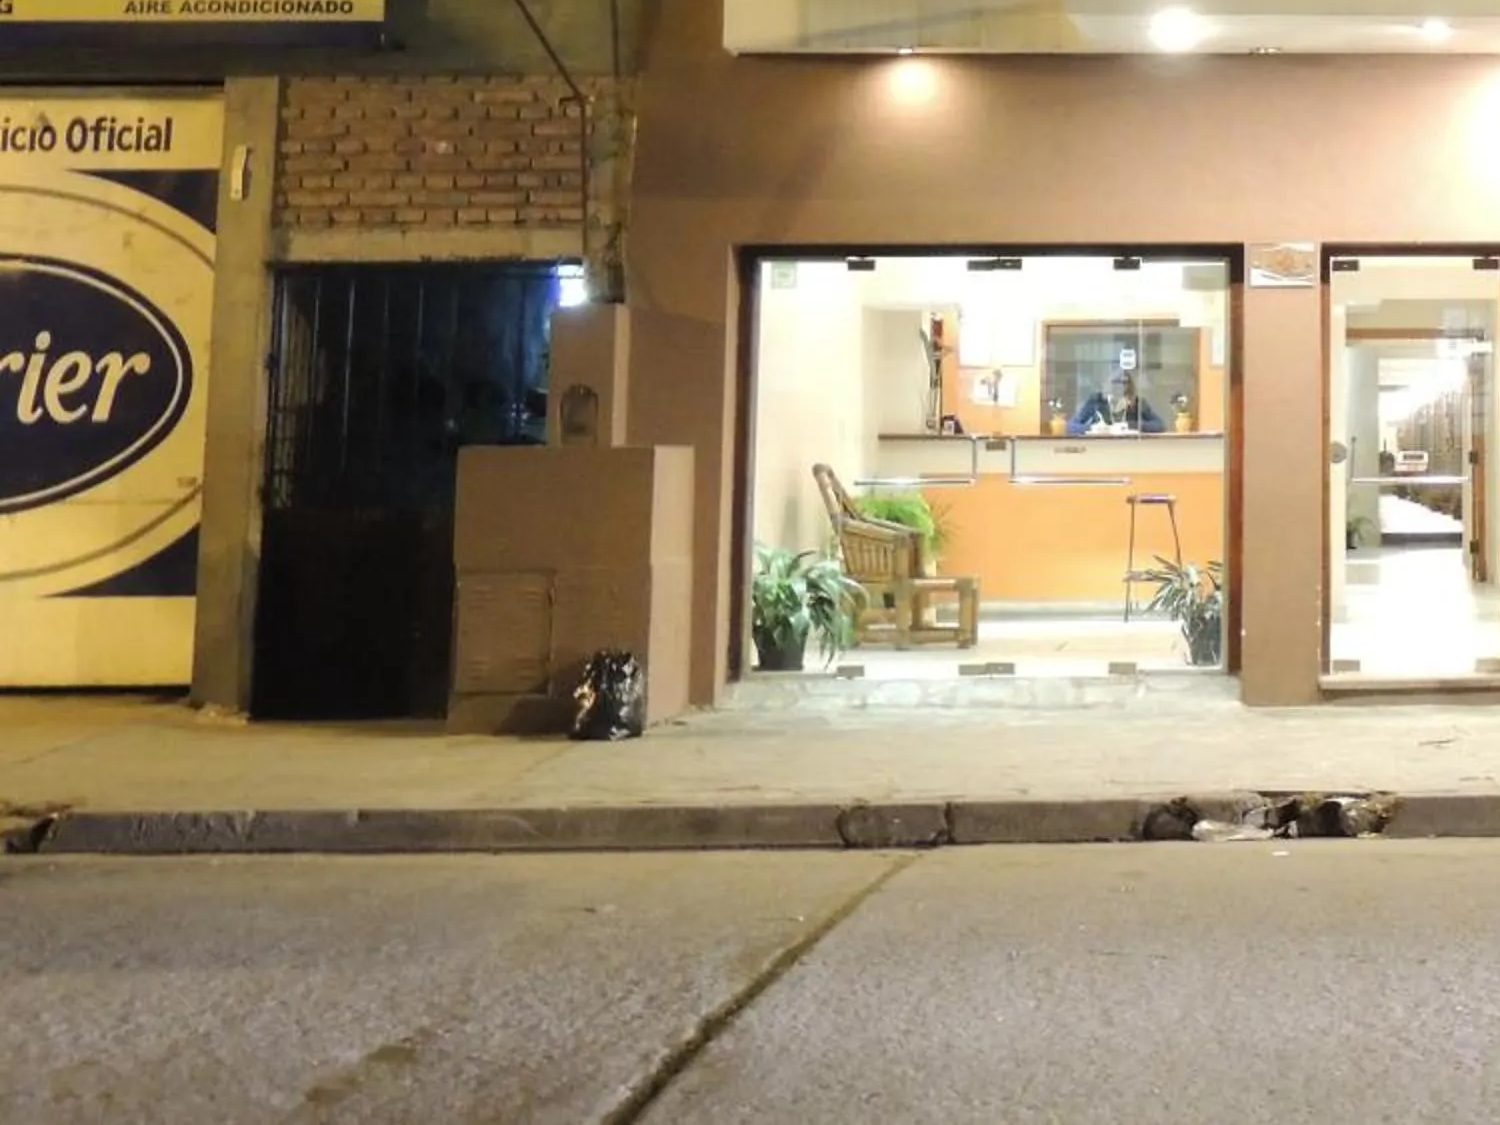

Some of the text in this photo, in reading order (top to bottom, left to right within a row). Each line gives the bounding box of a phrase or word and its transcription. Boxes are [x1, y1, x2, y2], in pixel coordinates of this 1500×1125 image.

[125, 0, 354, 15] AIRE ACONDICIONADO
[65, 116, 173, 153] Oficial
